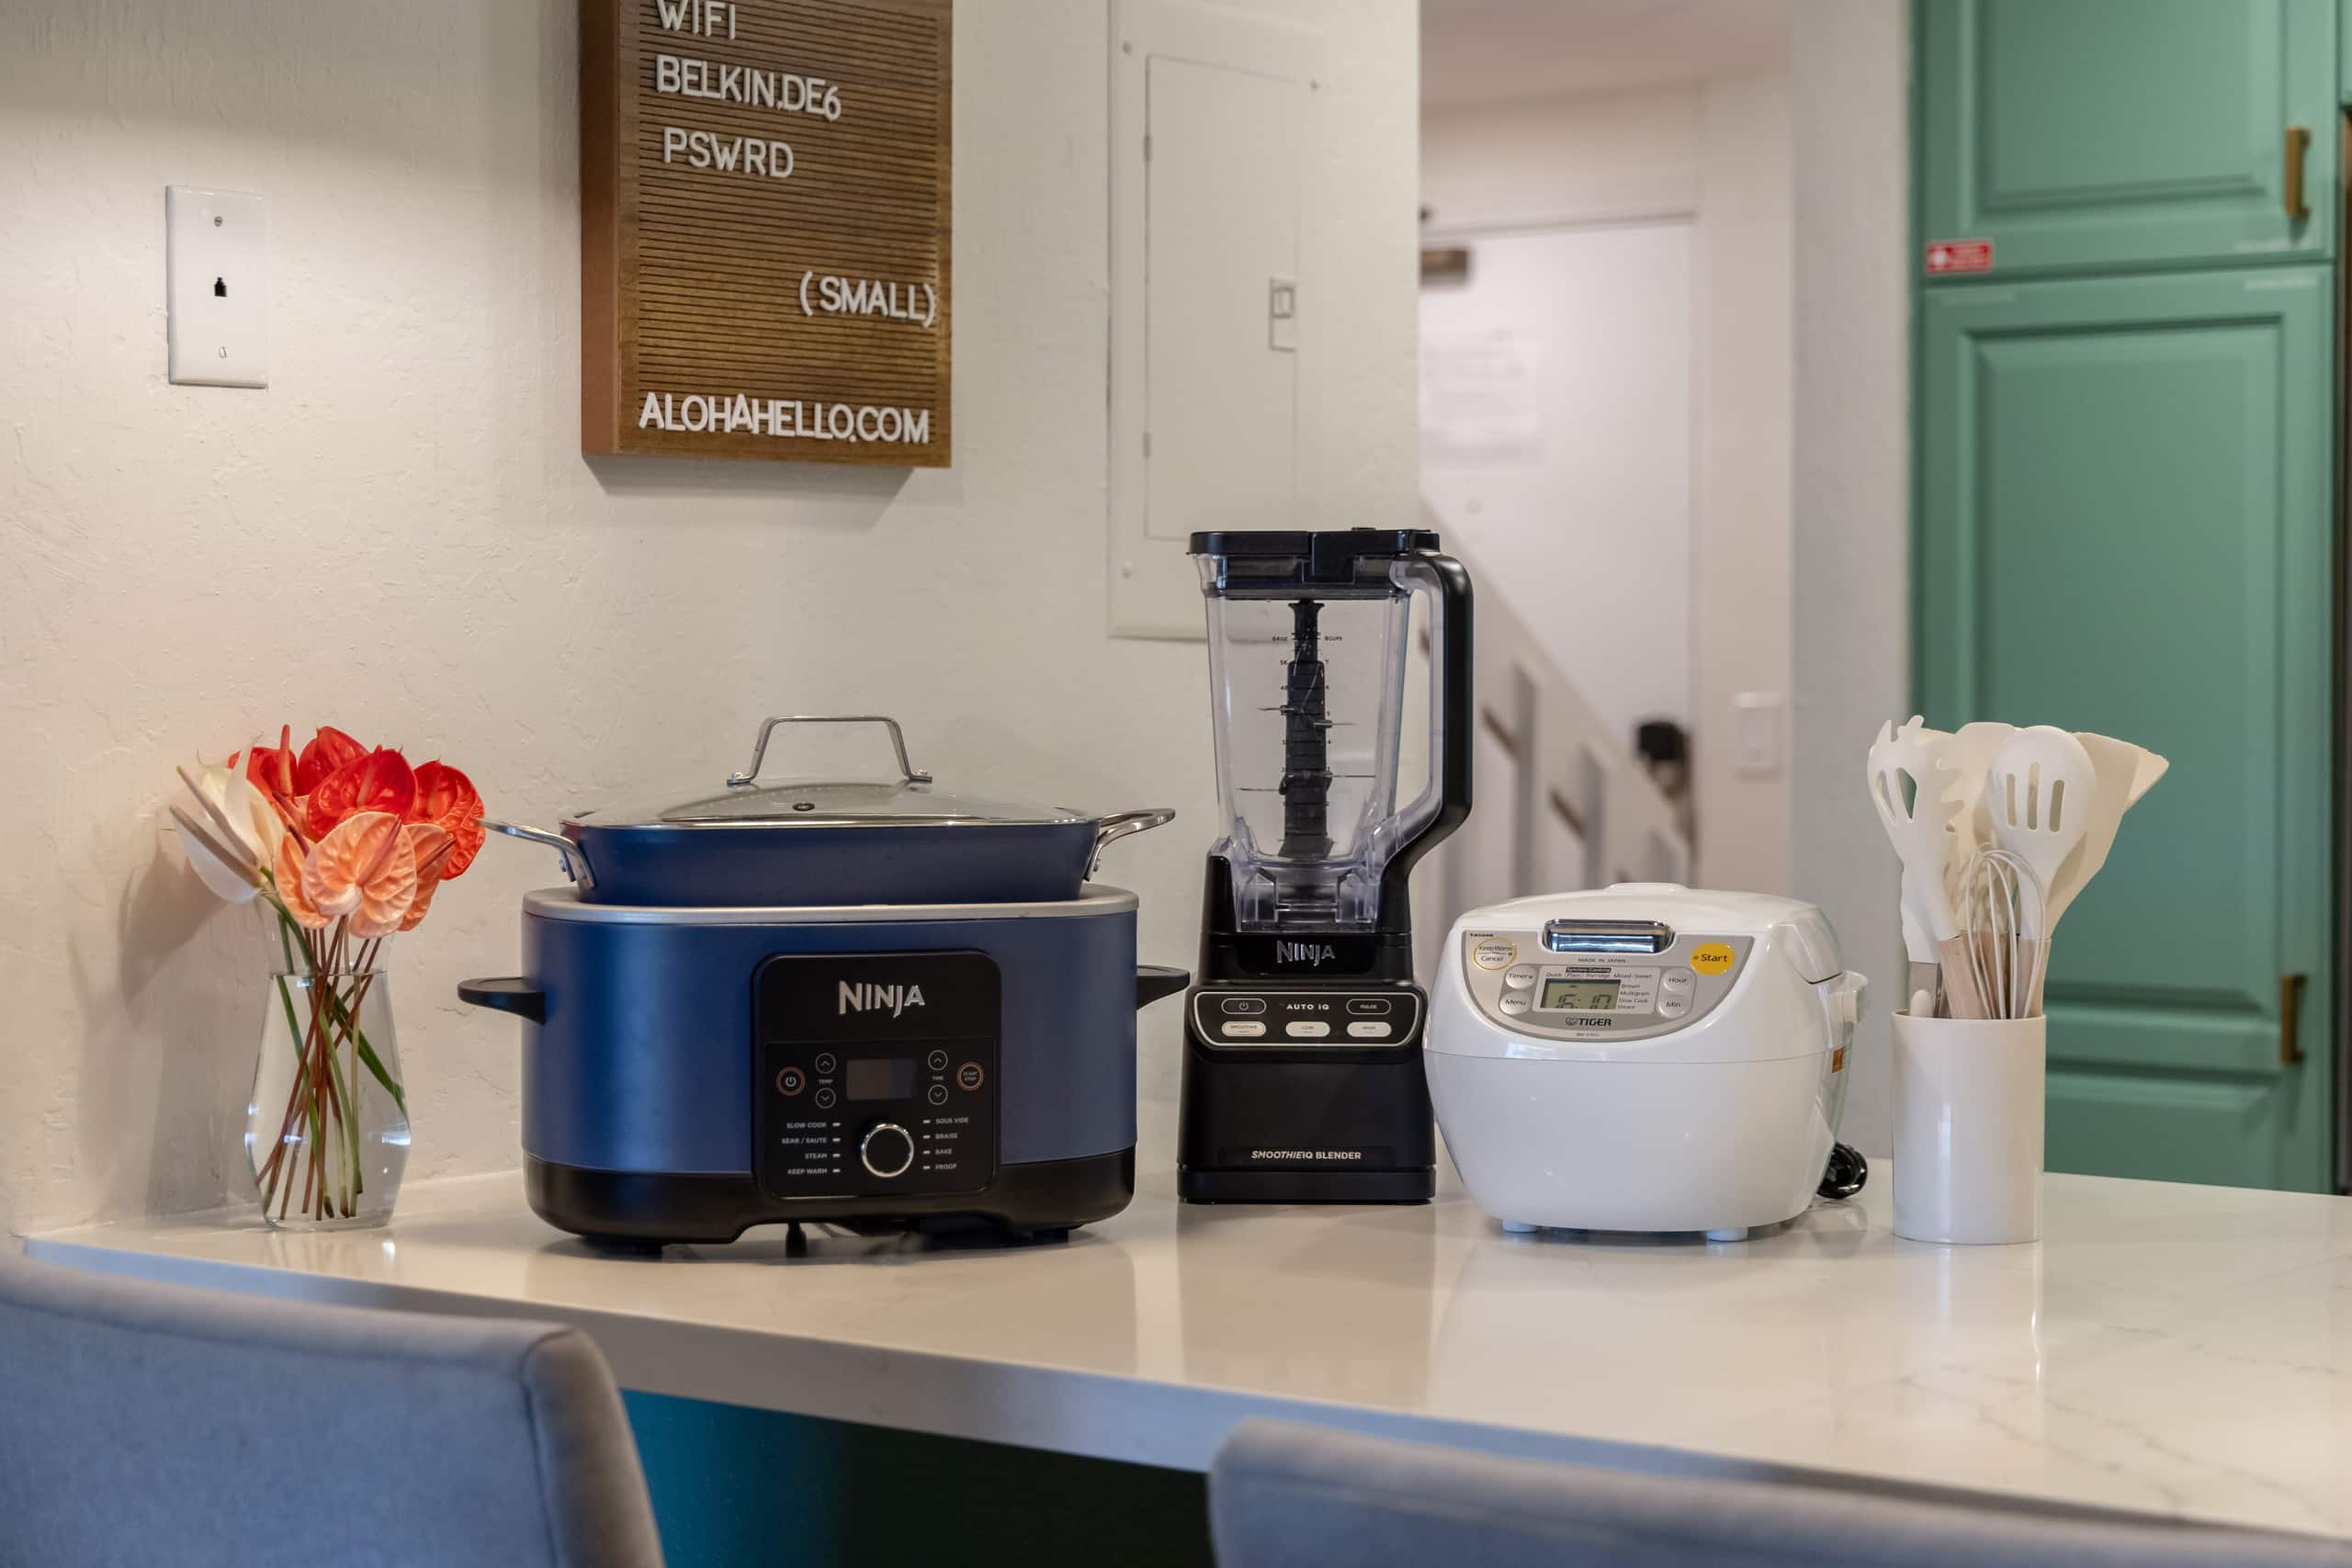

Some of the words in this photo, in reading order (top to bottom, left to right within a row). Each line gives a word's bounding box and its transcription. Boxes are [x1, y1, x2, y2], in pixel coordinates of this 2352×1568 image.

[656, 0, 736, 39] WIFI
[663, 127, 794, 177] PSWRD
[639, 391, 930, 444] ALOHAHELLO.COM
[1277, 940, 1336, 966] NINJA
[1701, 953, 1728, 963] Start
[839, 979, 926, 1019] NINJA
[1578, 1018, 1612, 1027] TIGER
[1315, 1151, 1362, 1160] BLENDER
